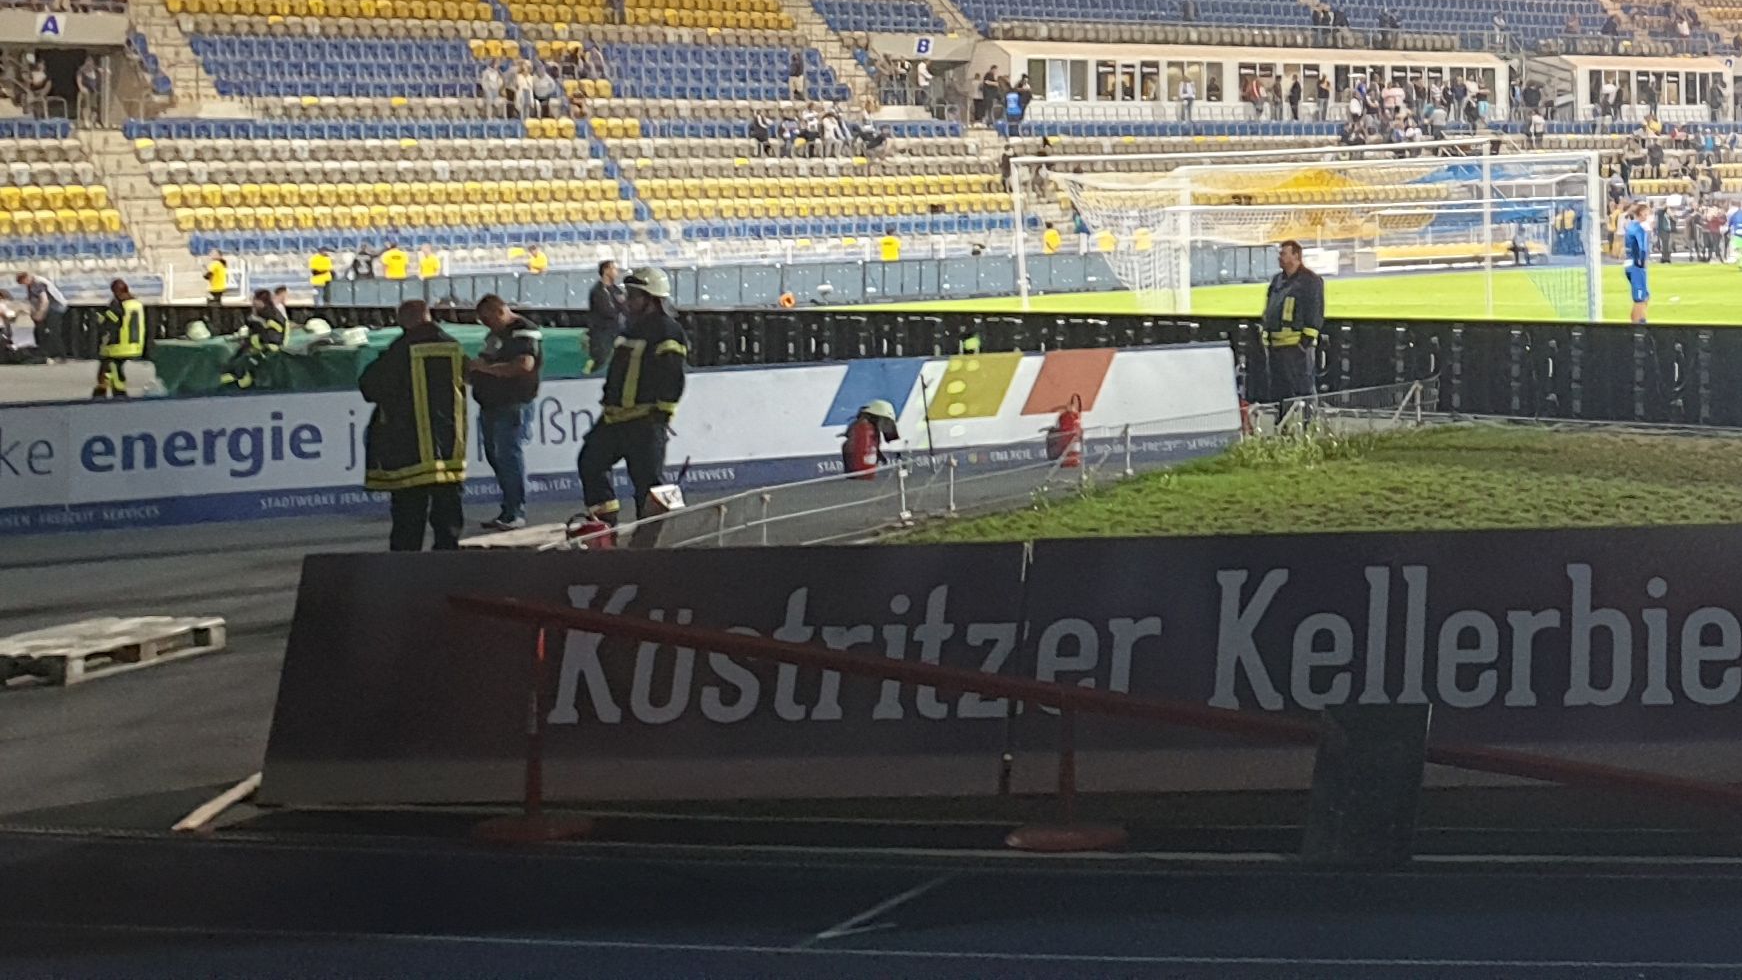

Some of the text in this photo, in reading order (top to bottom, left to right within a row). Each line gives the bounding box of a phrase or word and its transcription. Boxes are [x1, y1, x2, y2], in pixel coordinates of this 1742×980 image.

[41, 15, 60, 35] A
[917, 39, 931, 54] B
[80, 411, 323, 478] energie
[261, 493, 335, 510] STADTWERKE
[340, 491, 369, 505] JENA
